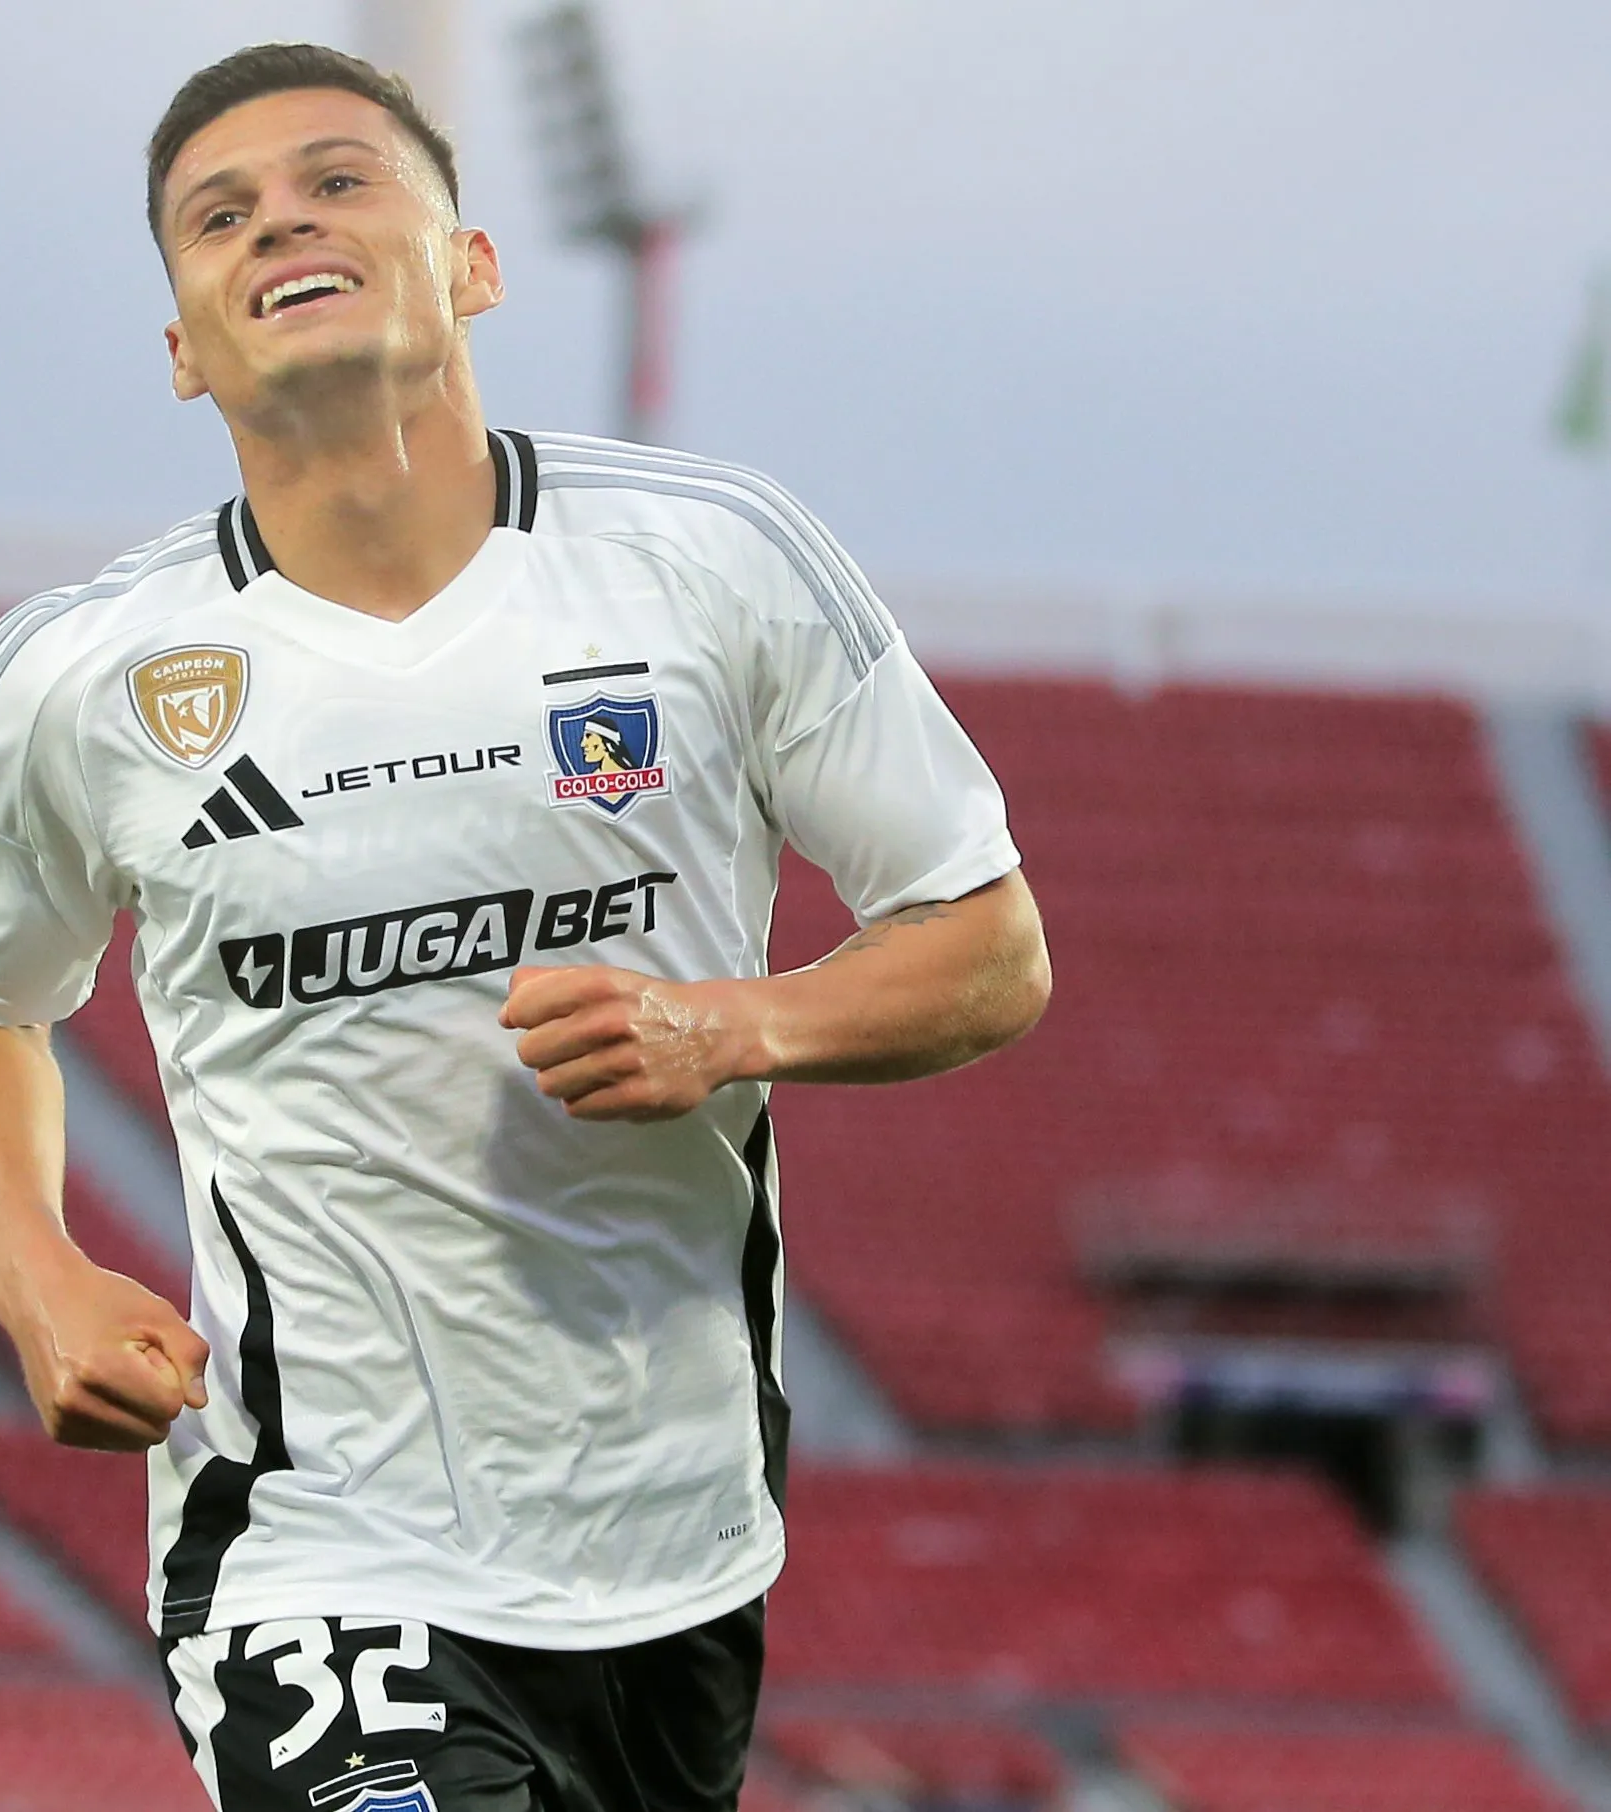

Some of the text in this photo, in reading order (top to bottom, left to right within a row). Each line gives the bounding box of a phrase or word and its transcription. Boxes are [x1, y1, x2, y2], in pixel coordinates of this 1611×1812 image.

[152, 656, 226, 679] CAMPEÓN
[301, 744, 522, 799] JETOUR
[559, 771, 660, 796] COLO-COLO
[244, 1616, 446, 1770] 32
